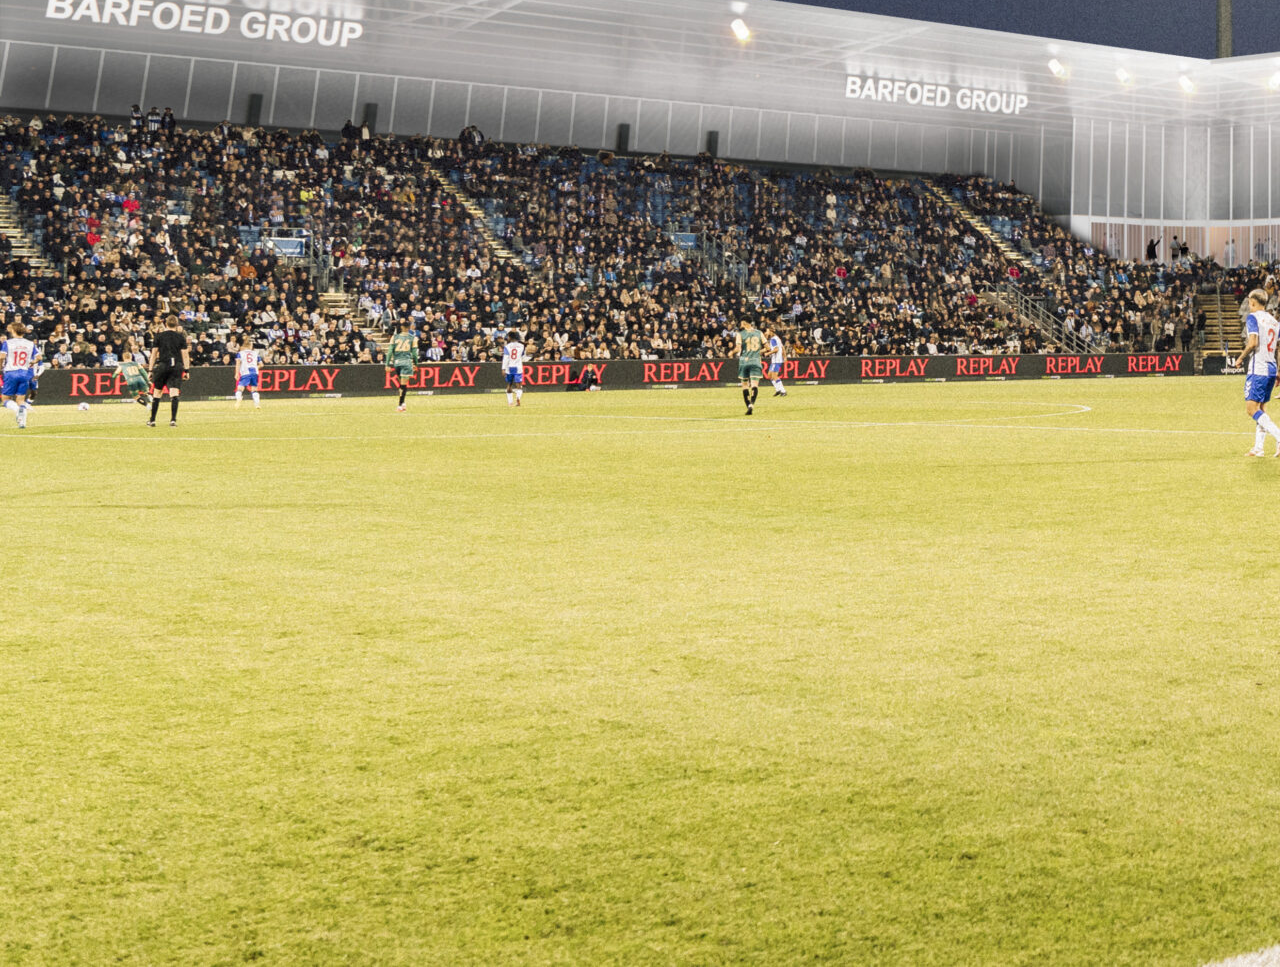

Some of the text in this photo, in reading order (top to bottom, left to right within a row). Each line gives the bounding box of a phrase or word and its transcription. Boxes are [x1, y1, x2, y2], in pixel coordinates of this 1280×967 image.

[240, 11, 363, 47] GROUP
[845, 76, 1028, 114] BARFOED GROUP
[395, 338, 411, 352] 26
[1267, 328, 1276, 352] 2
[13, 350, 28, 366] 18
[246, 352, 254, 364] 6
[510, 348, 518, 360] 8
[1128, 354, 1183, 372] REPLAY
[643, 362, 724, 383] REPLAY
[761, 359, 830, 379] RPLAY
[861, 358, 930, 377] REPLAY
[956, 356, 1020, 375] REPLAY
[1046, 355, 1104, 374] REPLAY
[234, 368, 341, 391] EPLAY
